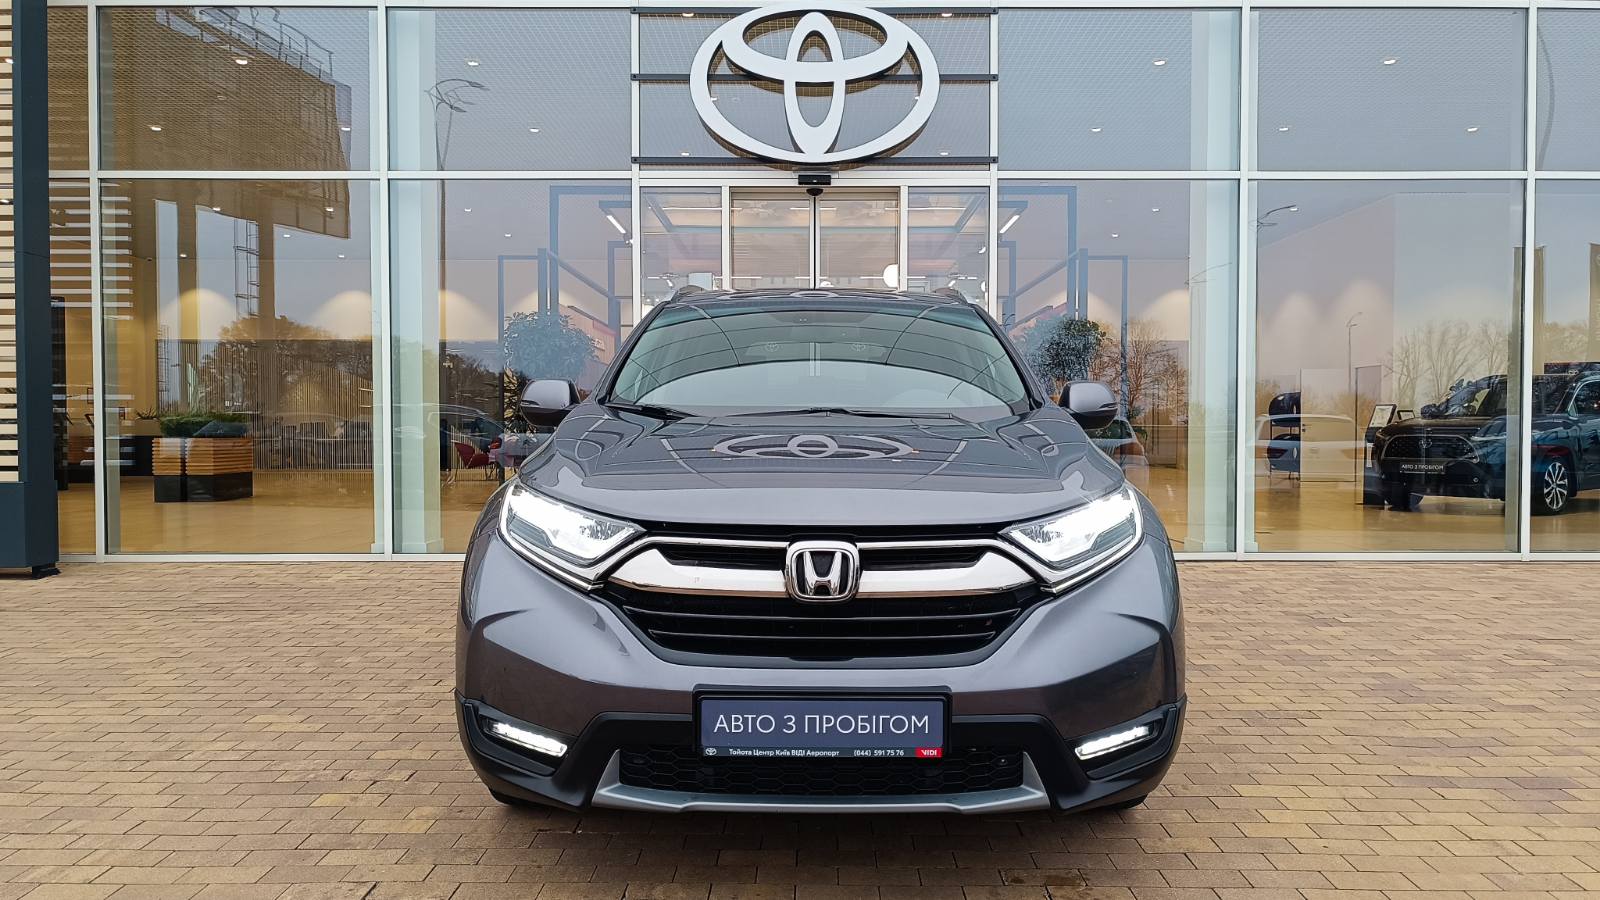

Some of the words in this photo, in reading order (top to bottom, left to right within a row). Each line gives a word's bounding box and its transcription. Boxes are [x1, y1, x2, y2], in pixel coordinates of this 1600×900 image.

[713, 714, 776, 734] АВТО
[782, 714, 796, 734] З
[804, 714, 929, 734] ПРОБІГОМ
[728, 748, 752, 756] Тойота
[753, 749, 774, 757] Центр
[791, 749, 805, 757] ВІДІ
[806, 749, 840, 757] Аеропорт
[853, 749, 872, 757] (044)
